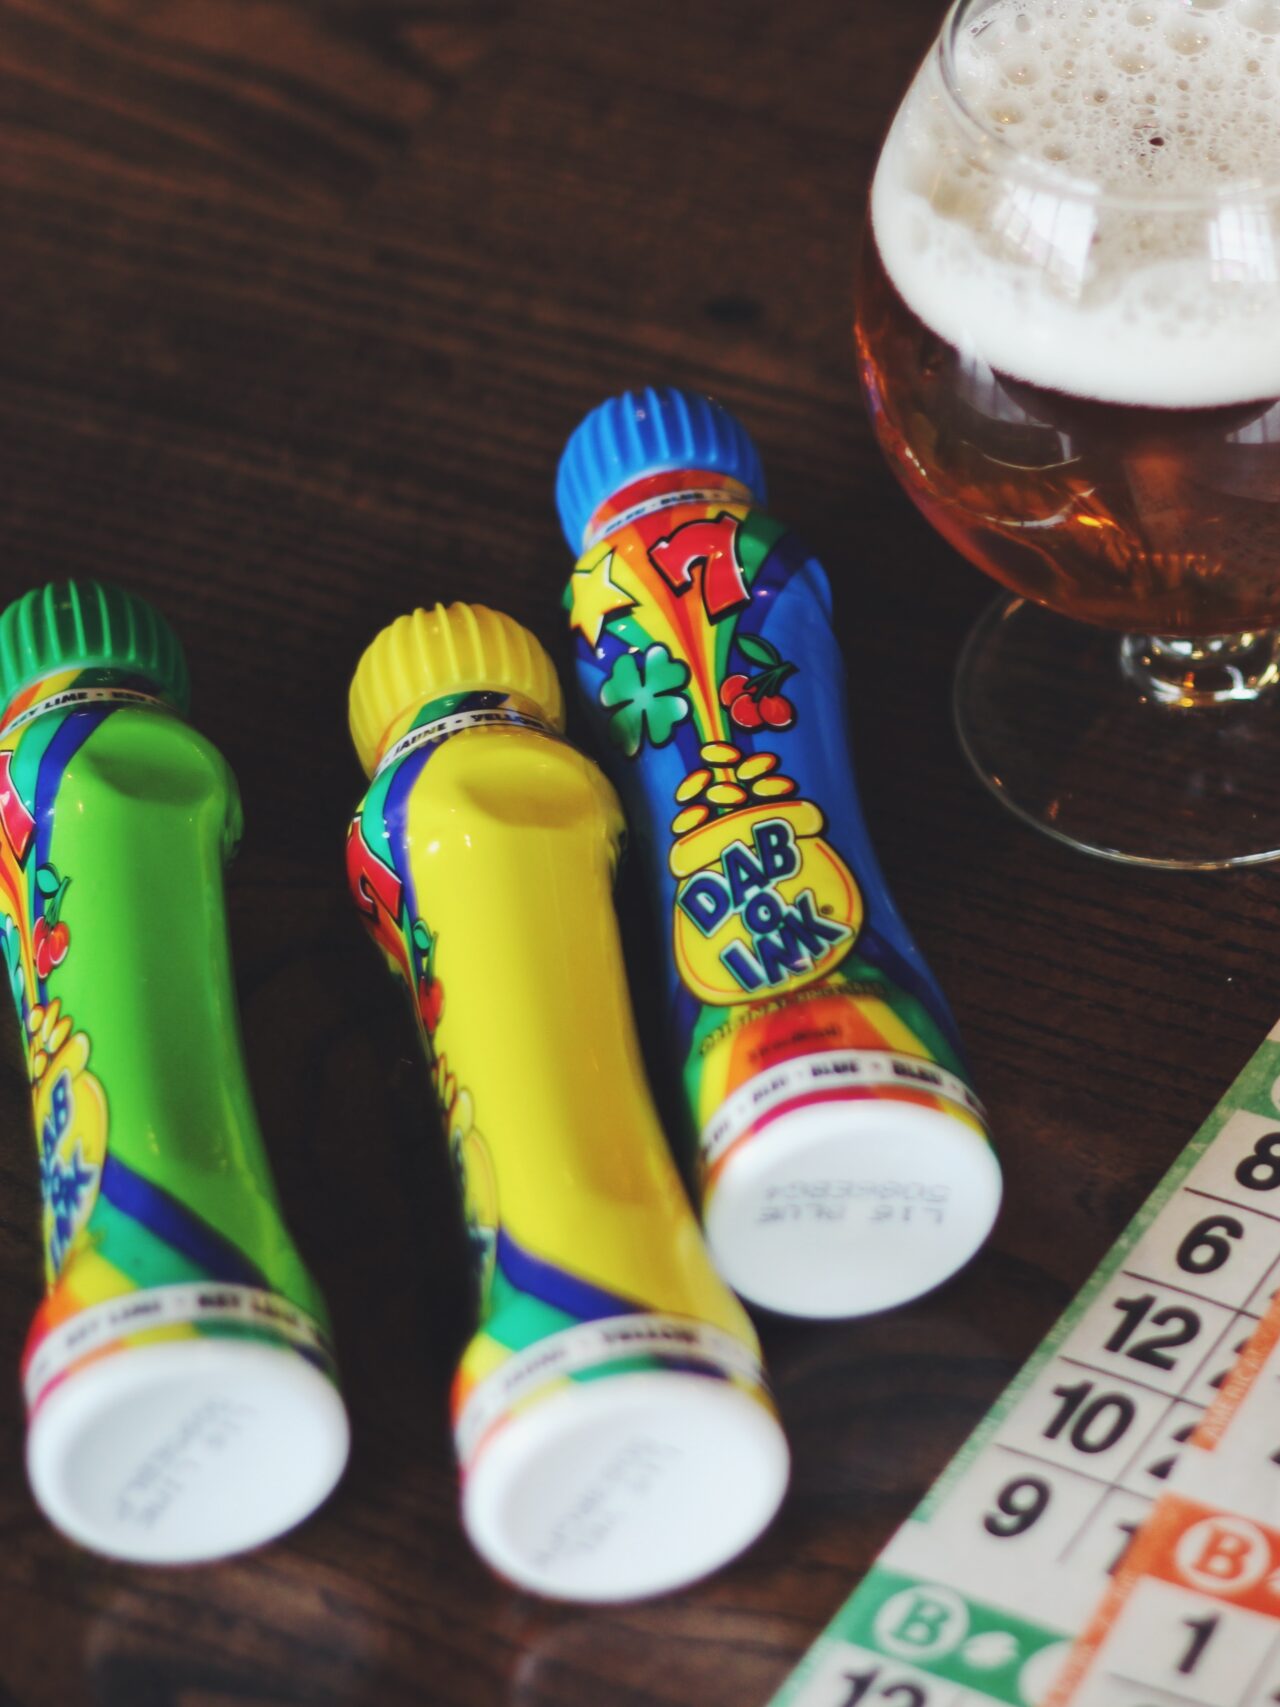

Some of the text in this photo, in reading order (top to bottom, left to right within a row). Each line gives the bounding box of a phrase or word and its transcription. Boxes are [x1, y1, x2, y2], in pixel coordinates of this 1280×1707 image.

[44, 692, 88, 709] LIME
[396, 723, 446, 754] JAUNE
[678, 817, 803, 938] DAB
[720, 889, 852, 992] INK
[743, 889, 785, 936] O
[1176, 1215, 1244, 1274] 6
[1104, 1295, 1200, 1371] 12
[1043, 1381, 1135, 1453] 10
[984, 1476, 1051, 1538] 9
[1194, 1526, 1253, 1580] B
[891, 1595, 951, 1647] B
[1178, 1615, 1220, 1675] 1
